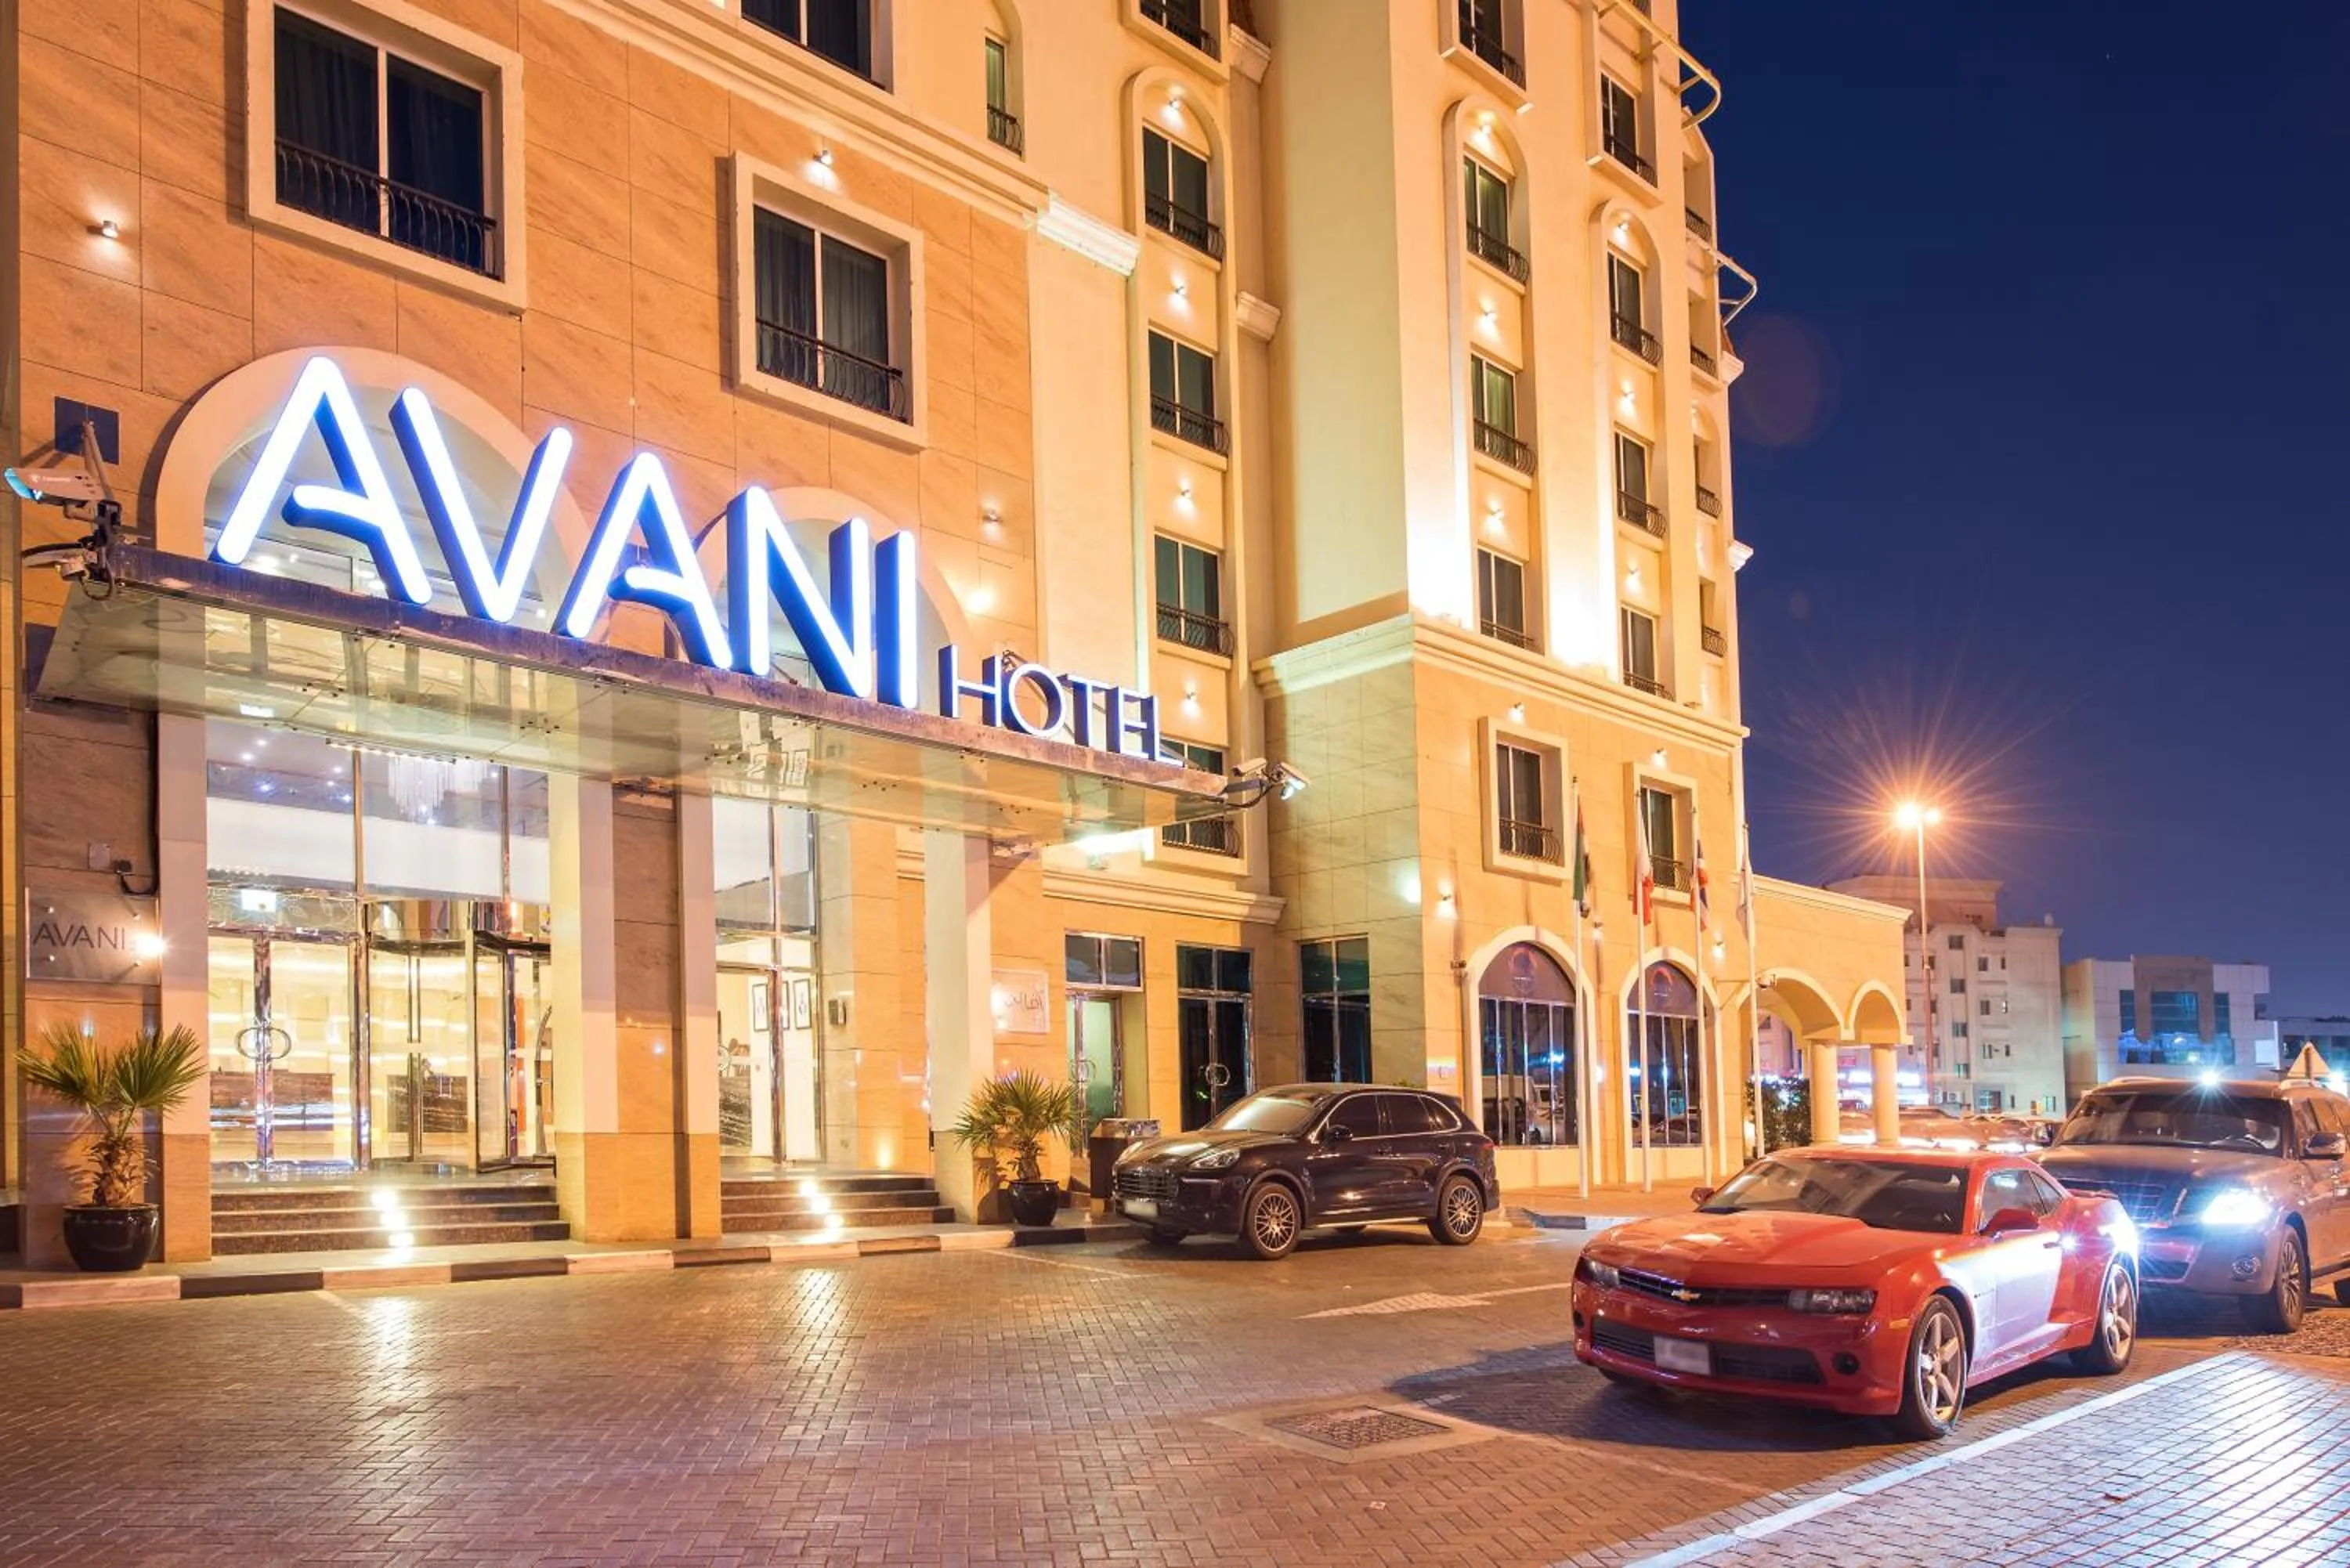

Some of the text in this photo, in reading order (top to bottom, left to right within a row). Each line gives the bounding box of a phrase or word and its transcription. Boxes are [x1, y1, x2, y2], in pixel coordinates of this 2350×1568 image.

[208, 356, 1184, 767] AVANI HOTEL
[33, 922, 125, 950] AVANI
